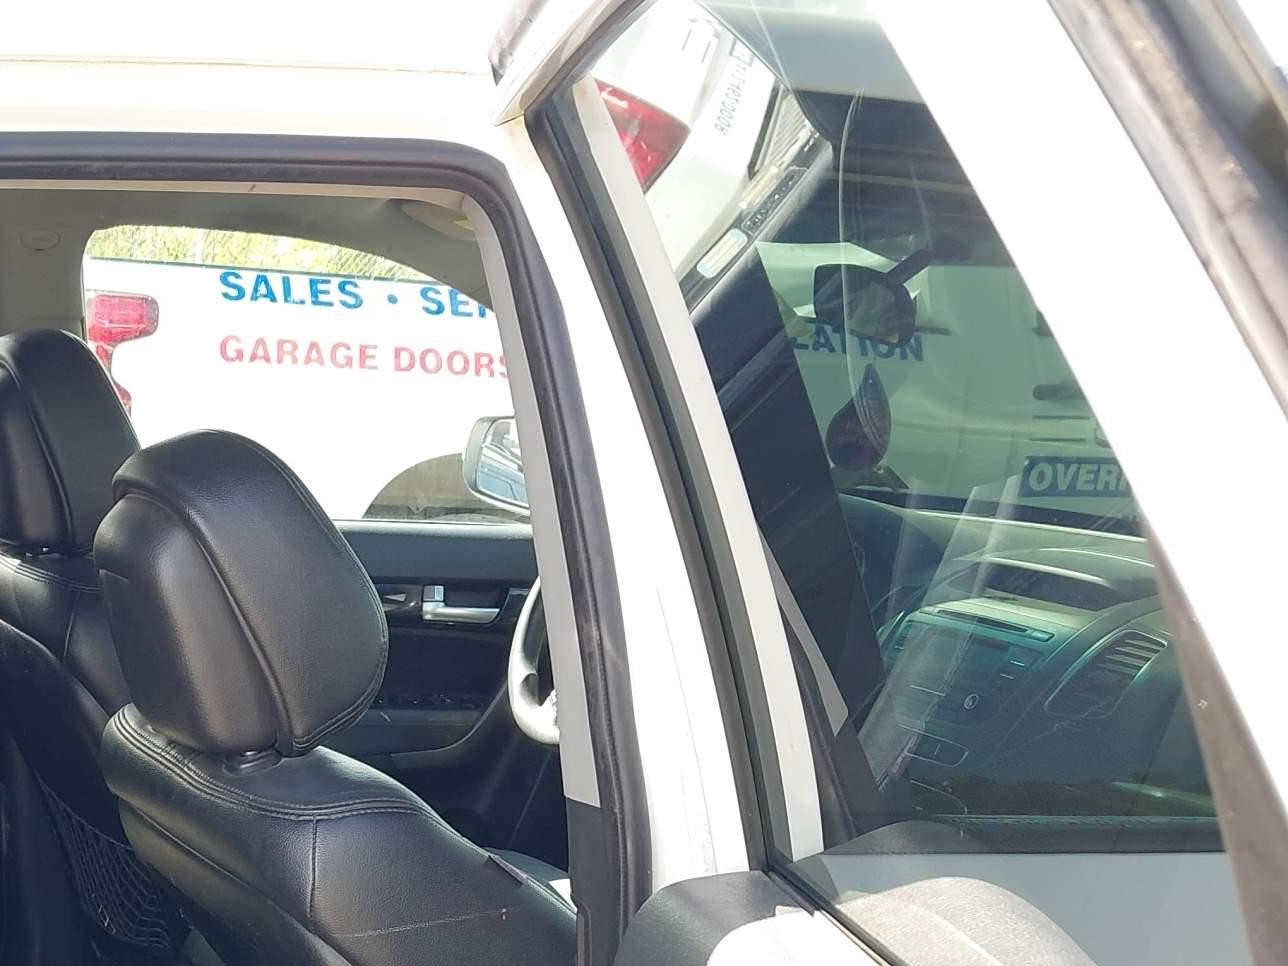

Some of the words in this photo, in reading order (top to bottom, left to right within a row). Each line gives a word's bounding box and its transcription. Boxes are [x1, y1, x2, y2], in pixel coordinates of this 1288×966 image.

[219, 270, 363, 310] SALES
[420, 286, 487, 319] SE
[219, 335, 378, 371] GARAGE
